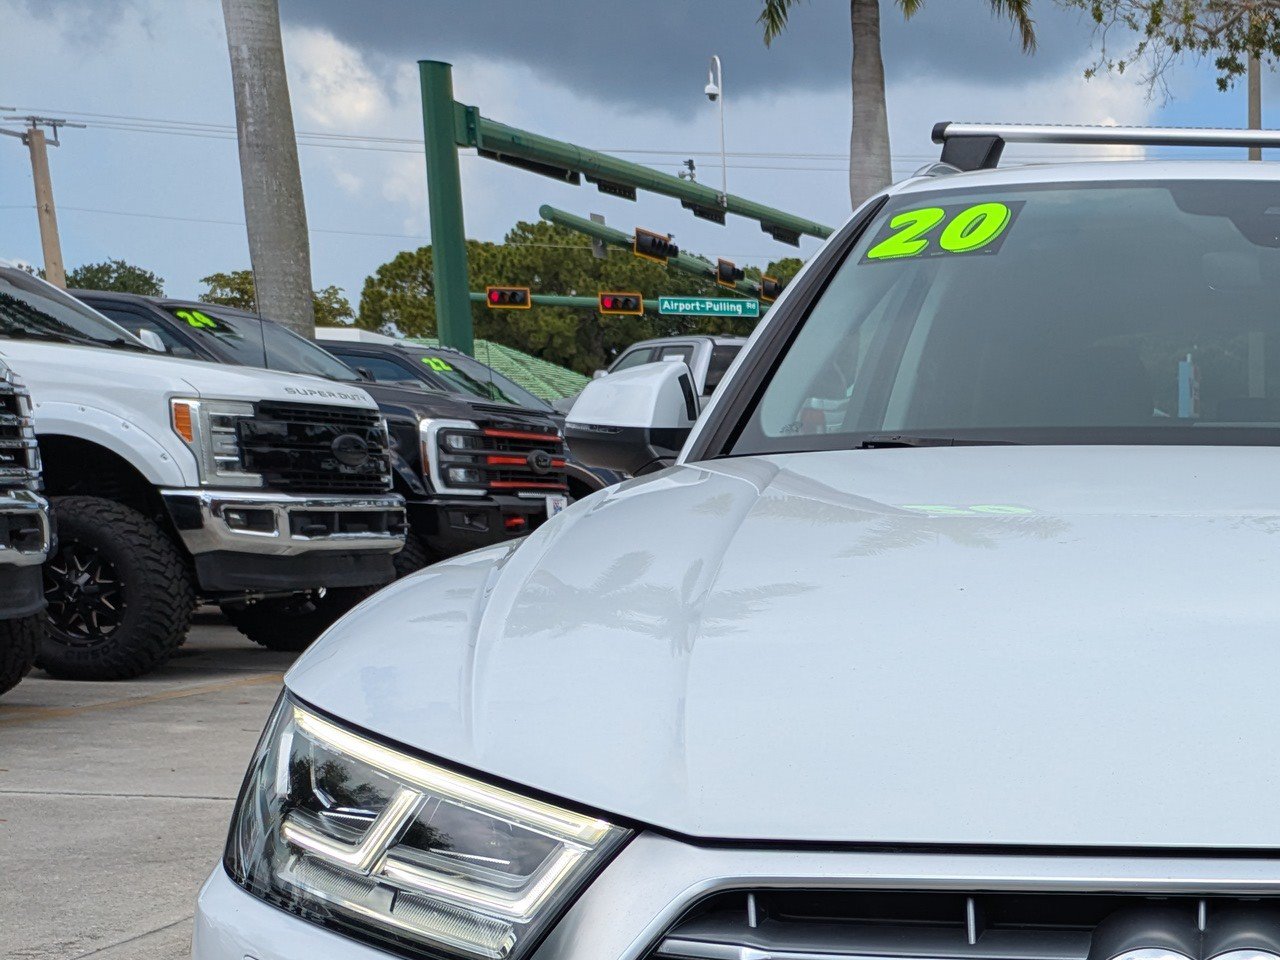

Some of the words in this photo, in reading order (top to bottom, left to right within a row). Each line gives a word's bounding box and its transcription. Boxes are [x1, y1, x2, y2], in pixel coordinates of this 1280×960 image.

[866, 202, 1012, 260] 20
[662, 300, 743, 315] Airport-Pulling
[284, 387, 336, 399] SUPER
[337, 392, 368, 401] DUTY
